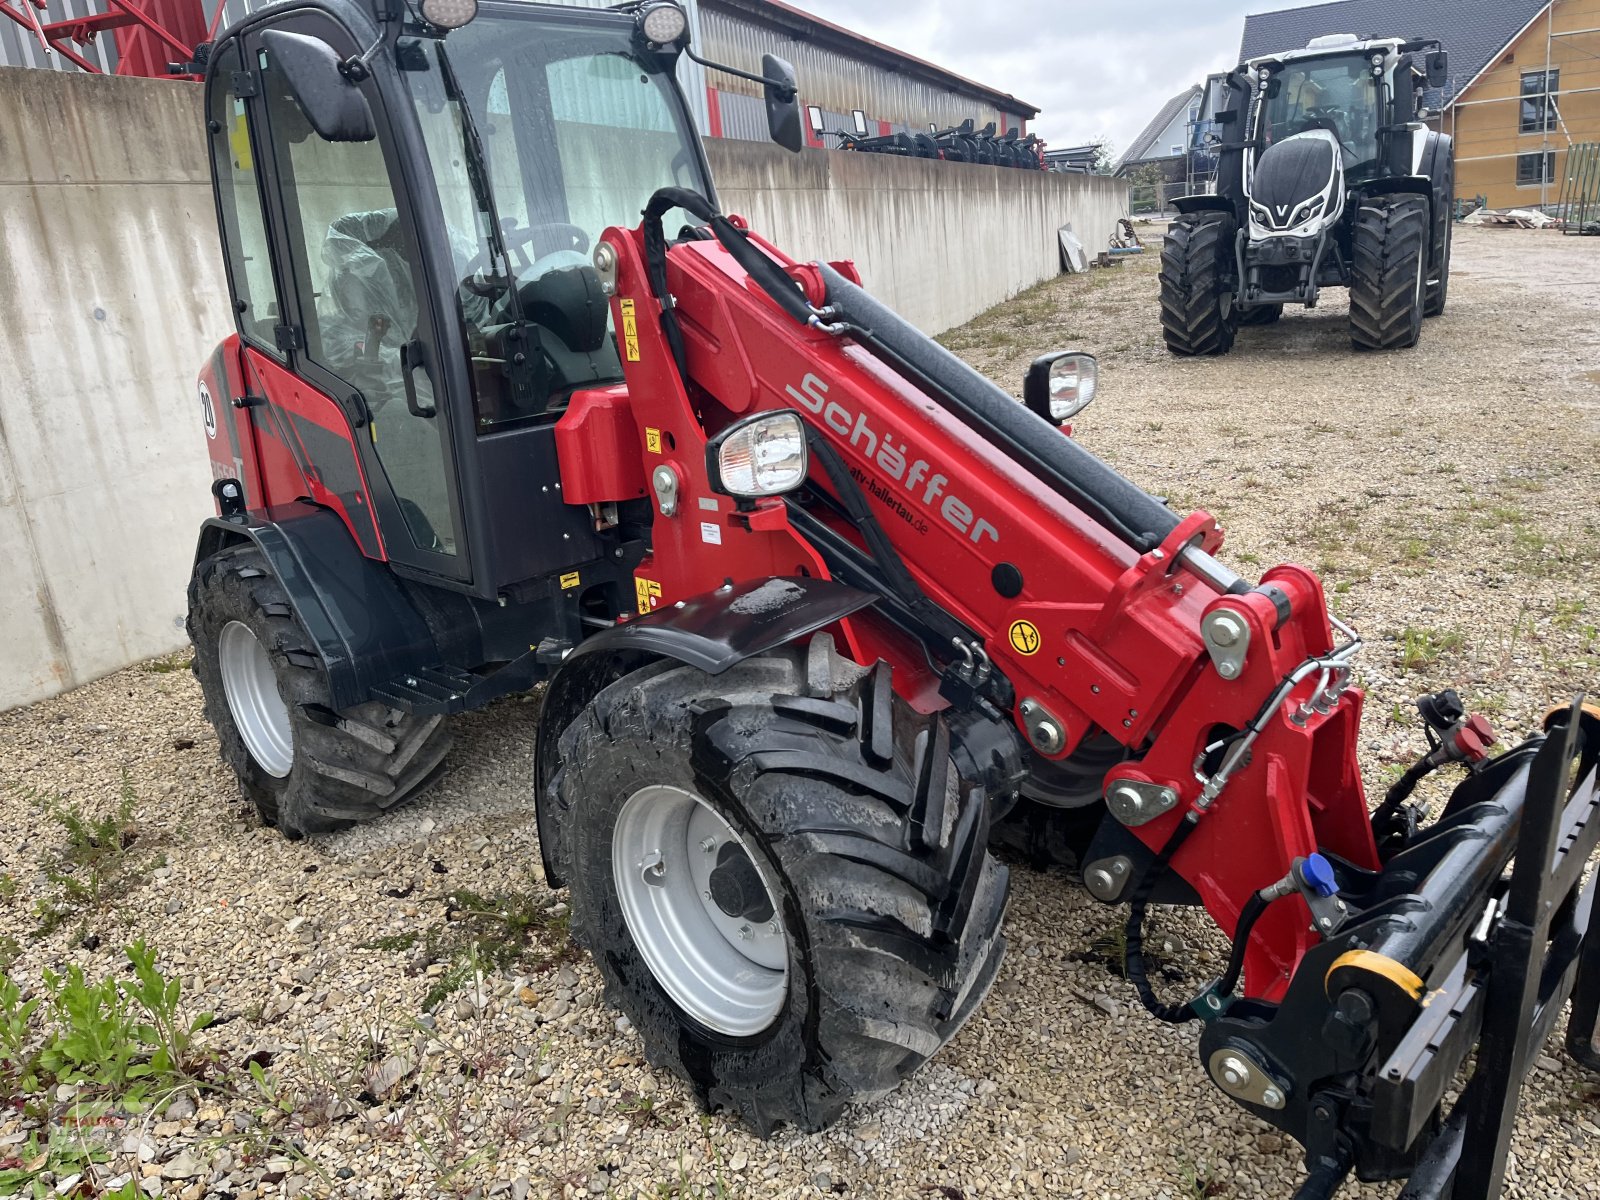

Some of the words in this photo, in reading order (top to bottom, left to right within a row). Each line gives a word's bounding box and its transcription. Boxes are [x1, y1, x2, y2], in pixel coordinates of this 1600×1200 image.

[201, 391, 214, 429] 20
[785, 372, 1000, 543] Schäffer
[840, 457, 929, 536] atv-hallertau.de
